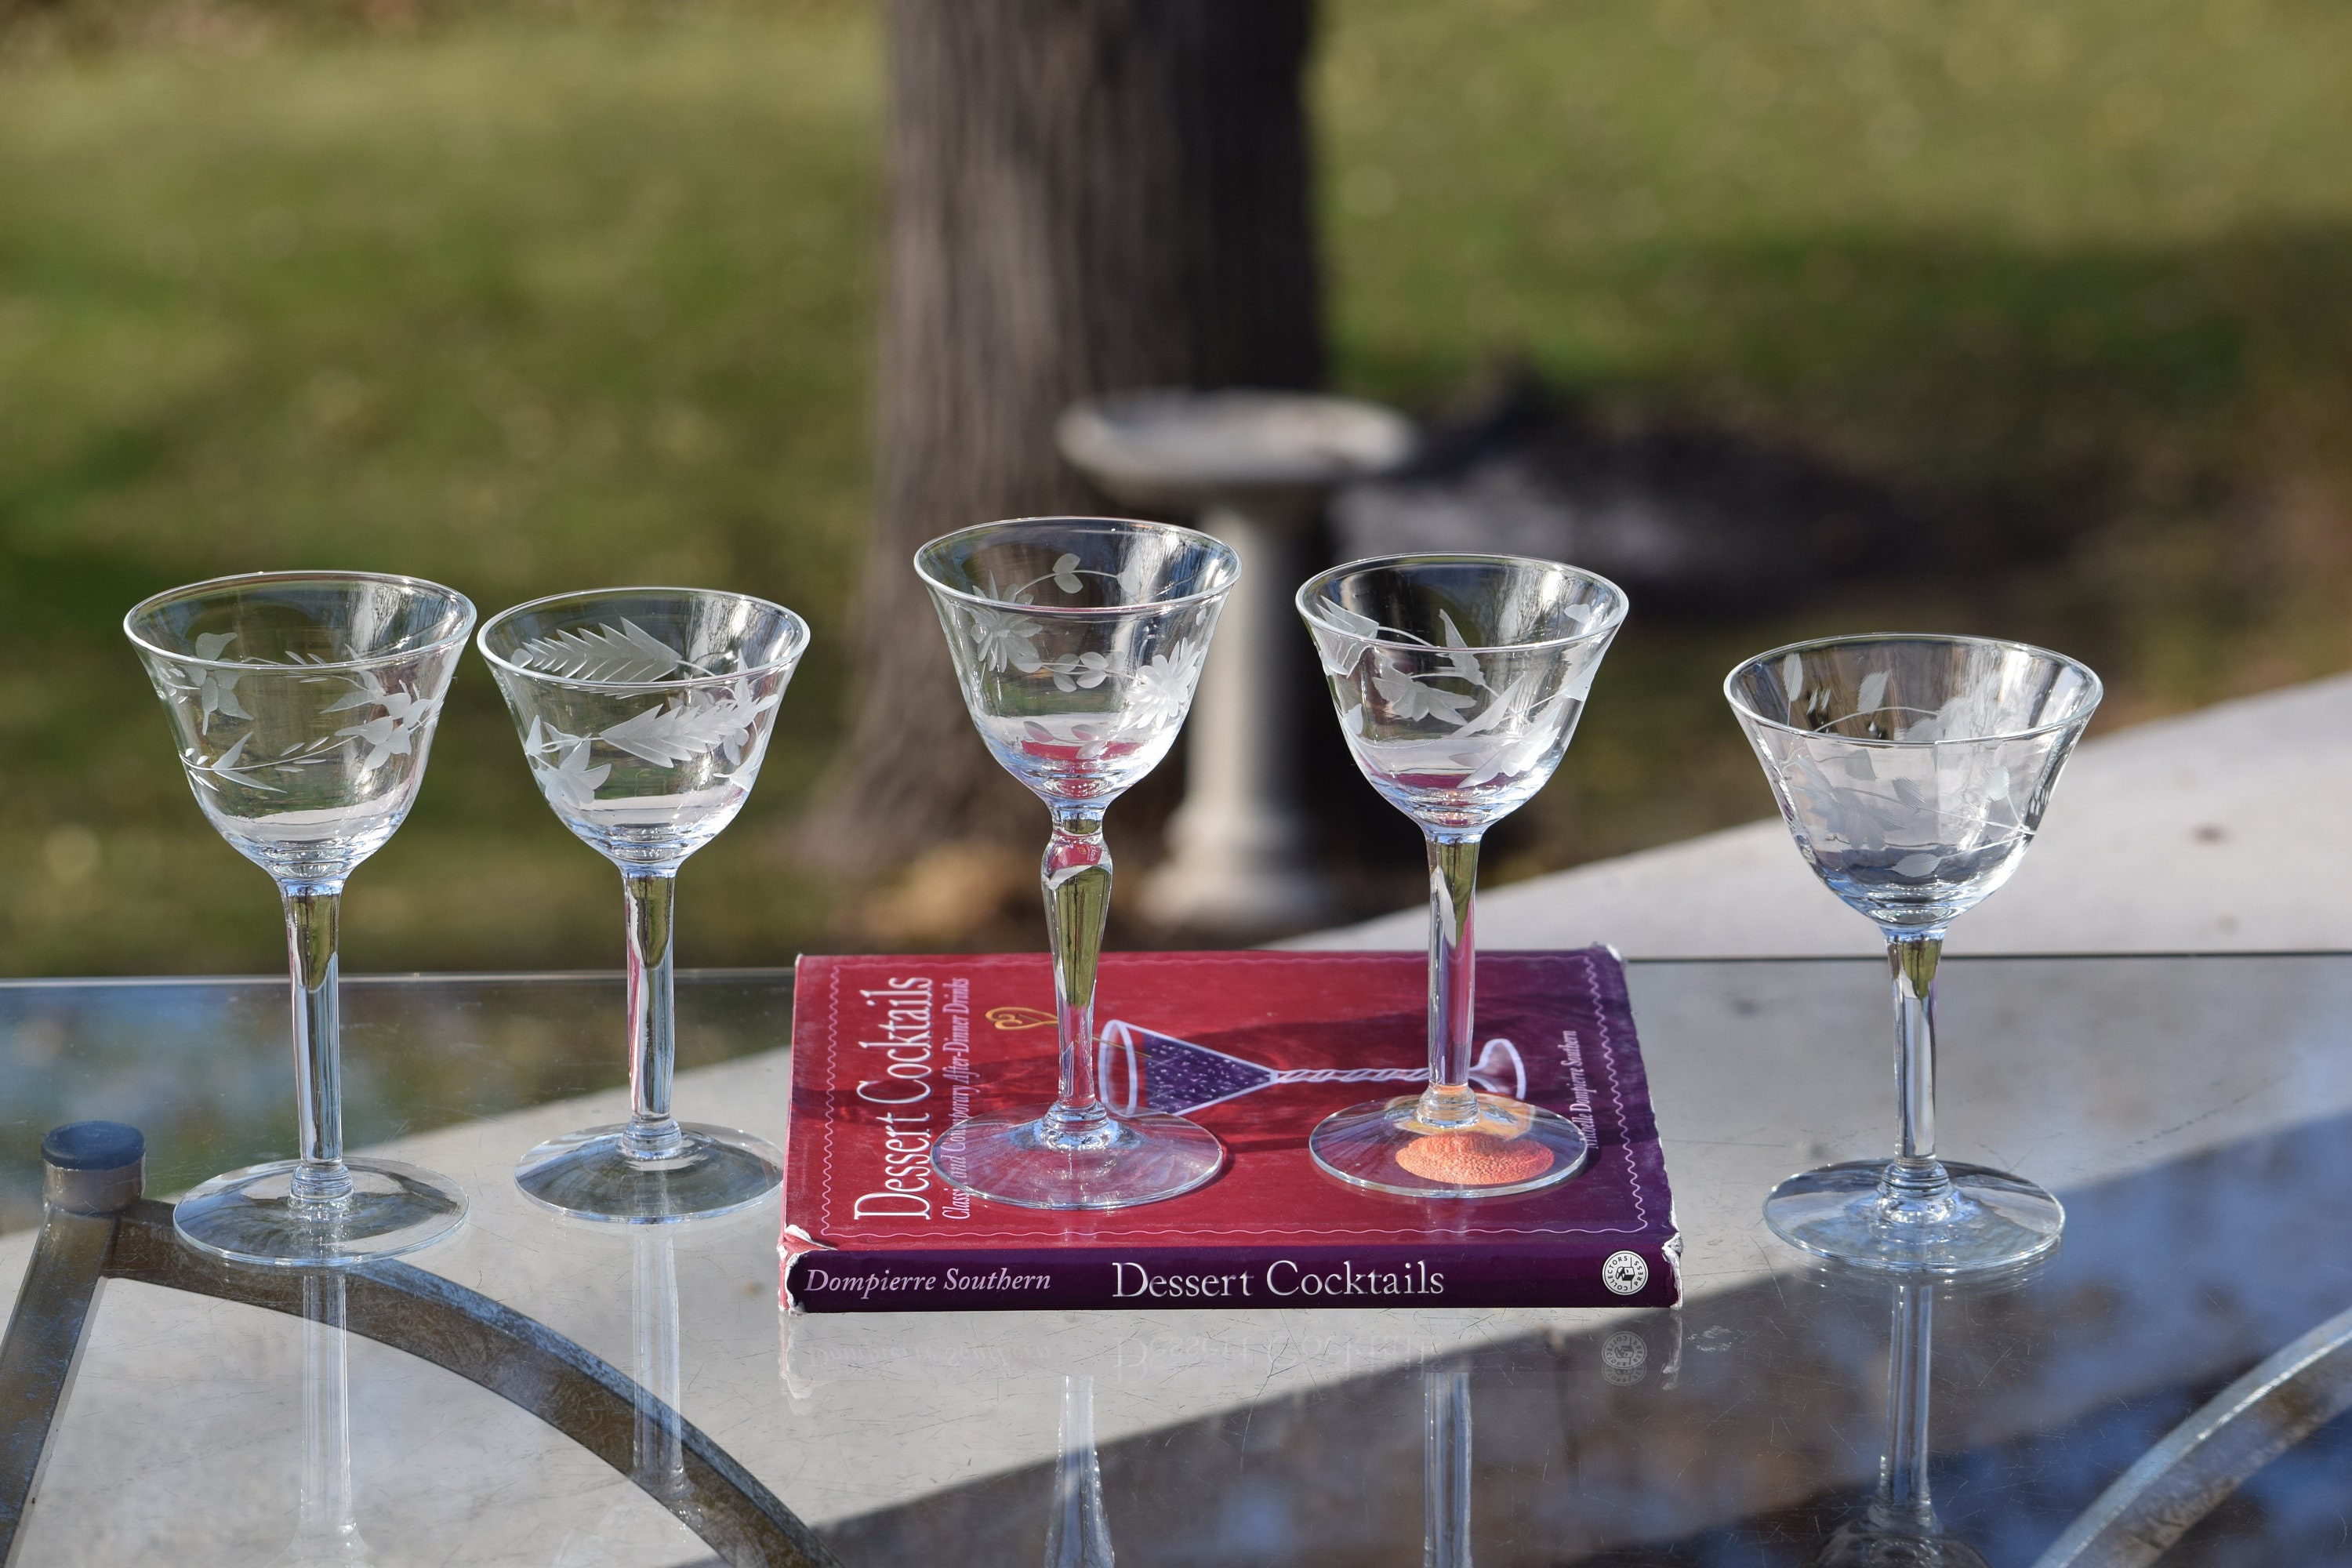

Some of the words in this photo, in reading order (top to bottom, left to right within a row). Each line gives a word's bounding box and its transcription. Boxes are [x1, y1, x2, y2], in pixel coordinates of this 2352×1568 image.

[942, 978, 970, 1014] Drinks
[857, 977, 932, 1104] Cocktails
[942, 1015, 980, 1085] After-Dinner
[1558, 1030, 1584, 1066] Southern
[1566, 1067, 1597, 1112] Dompierre
[940, 1084, 980, 1152] Conporary
[855, 1112, 931, 1220] Dessert
[940, 1155, 968, 1178] and
[942, 1182, 971, 1220] Classi
[804, 1269, 937, 1299] Dompierre
[943, 1268, 1051, 1290] Southern
[1112, 1262, 1254, 1298] Dessert
[1266, 1260, 1445, 1296] Cocktails
[1607, 1256, 1628, 1291] COLLECTORS
[1633, 1261, 1644, 1287] PRESS
